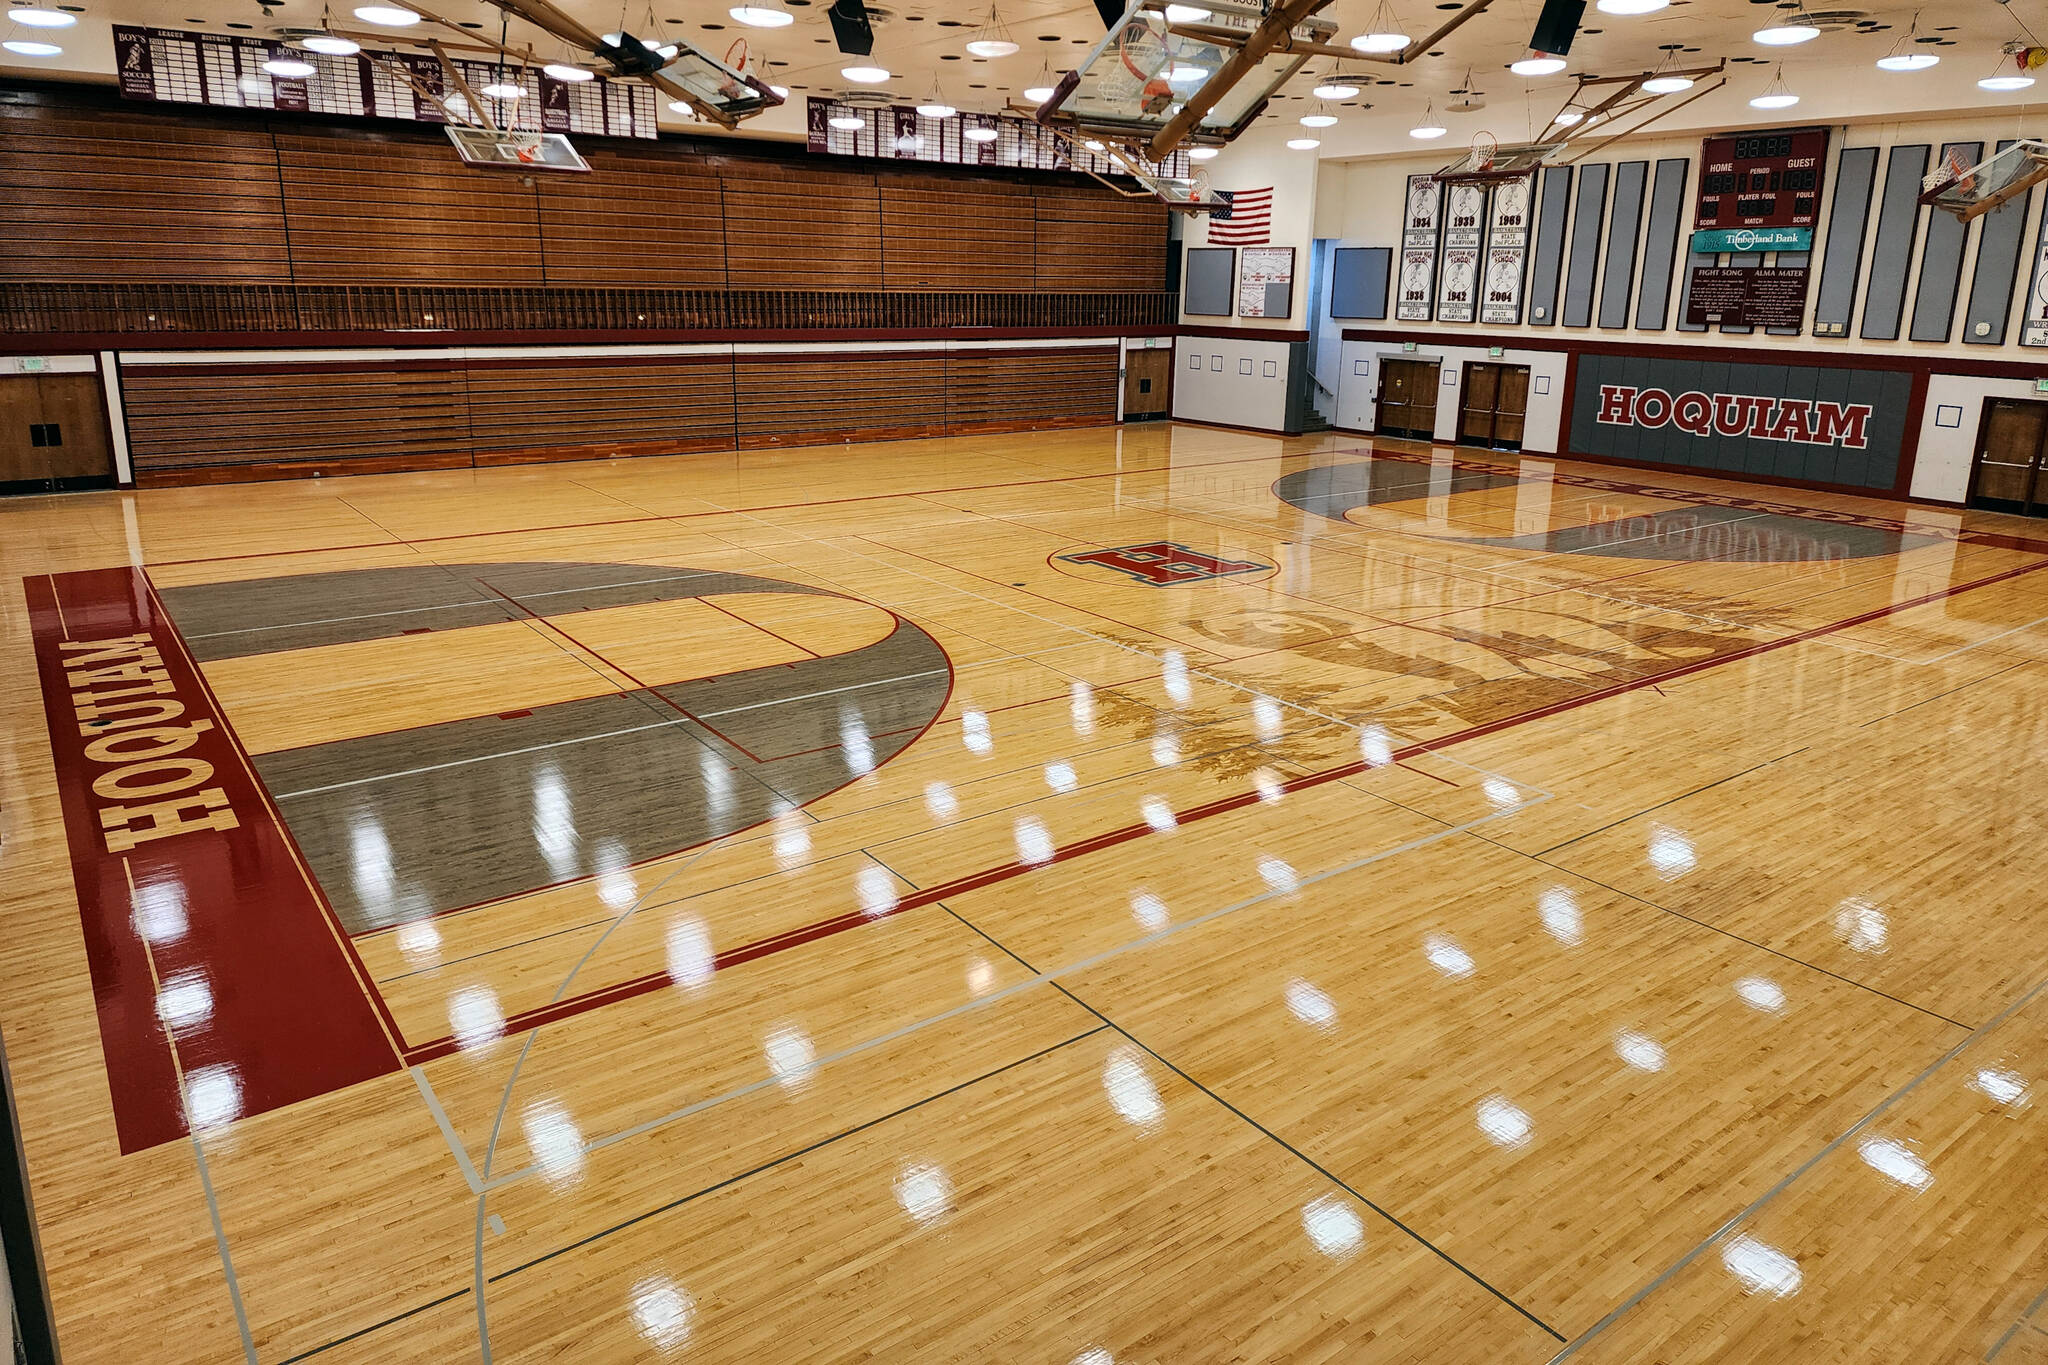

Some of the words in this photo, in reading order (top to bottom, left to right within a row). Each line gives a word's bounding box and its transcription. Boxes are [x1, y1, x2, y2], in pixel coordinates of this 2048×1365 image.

[118, 33, 146, 44] BOY'S
[276, 47, 302, 58] BOY'S
[417, 60, 440, 71] BOY'S
[1710, 163, 1733, 173] HOME
[1787, 158, 1816, 168] GUEST
[1796, 191, 1815, 199] FOULS
[1412, 217, 1431, 228] 1934
[1453, 216, 1475, 227] 1939
[1499, 215, 1521, 226] 1969
[1726, 234, 1774, 244] Timberland
[1776, 232, 1799, 243] Bank
[1405, 290, 1424, 301] 1936
[1447, 291, 1467, 302] 1942
[1490, 291, 1512, 302] 2004
[2031, 337, 2046, 345] 2nd
[1597, 385, 1873, 450] HOQUIAM
[1386, 454, 1629, 490] SQUARE
[1637, 488, 1990, 541] GARDEN
[58, 632, 241, 854] HOQUIAM
